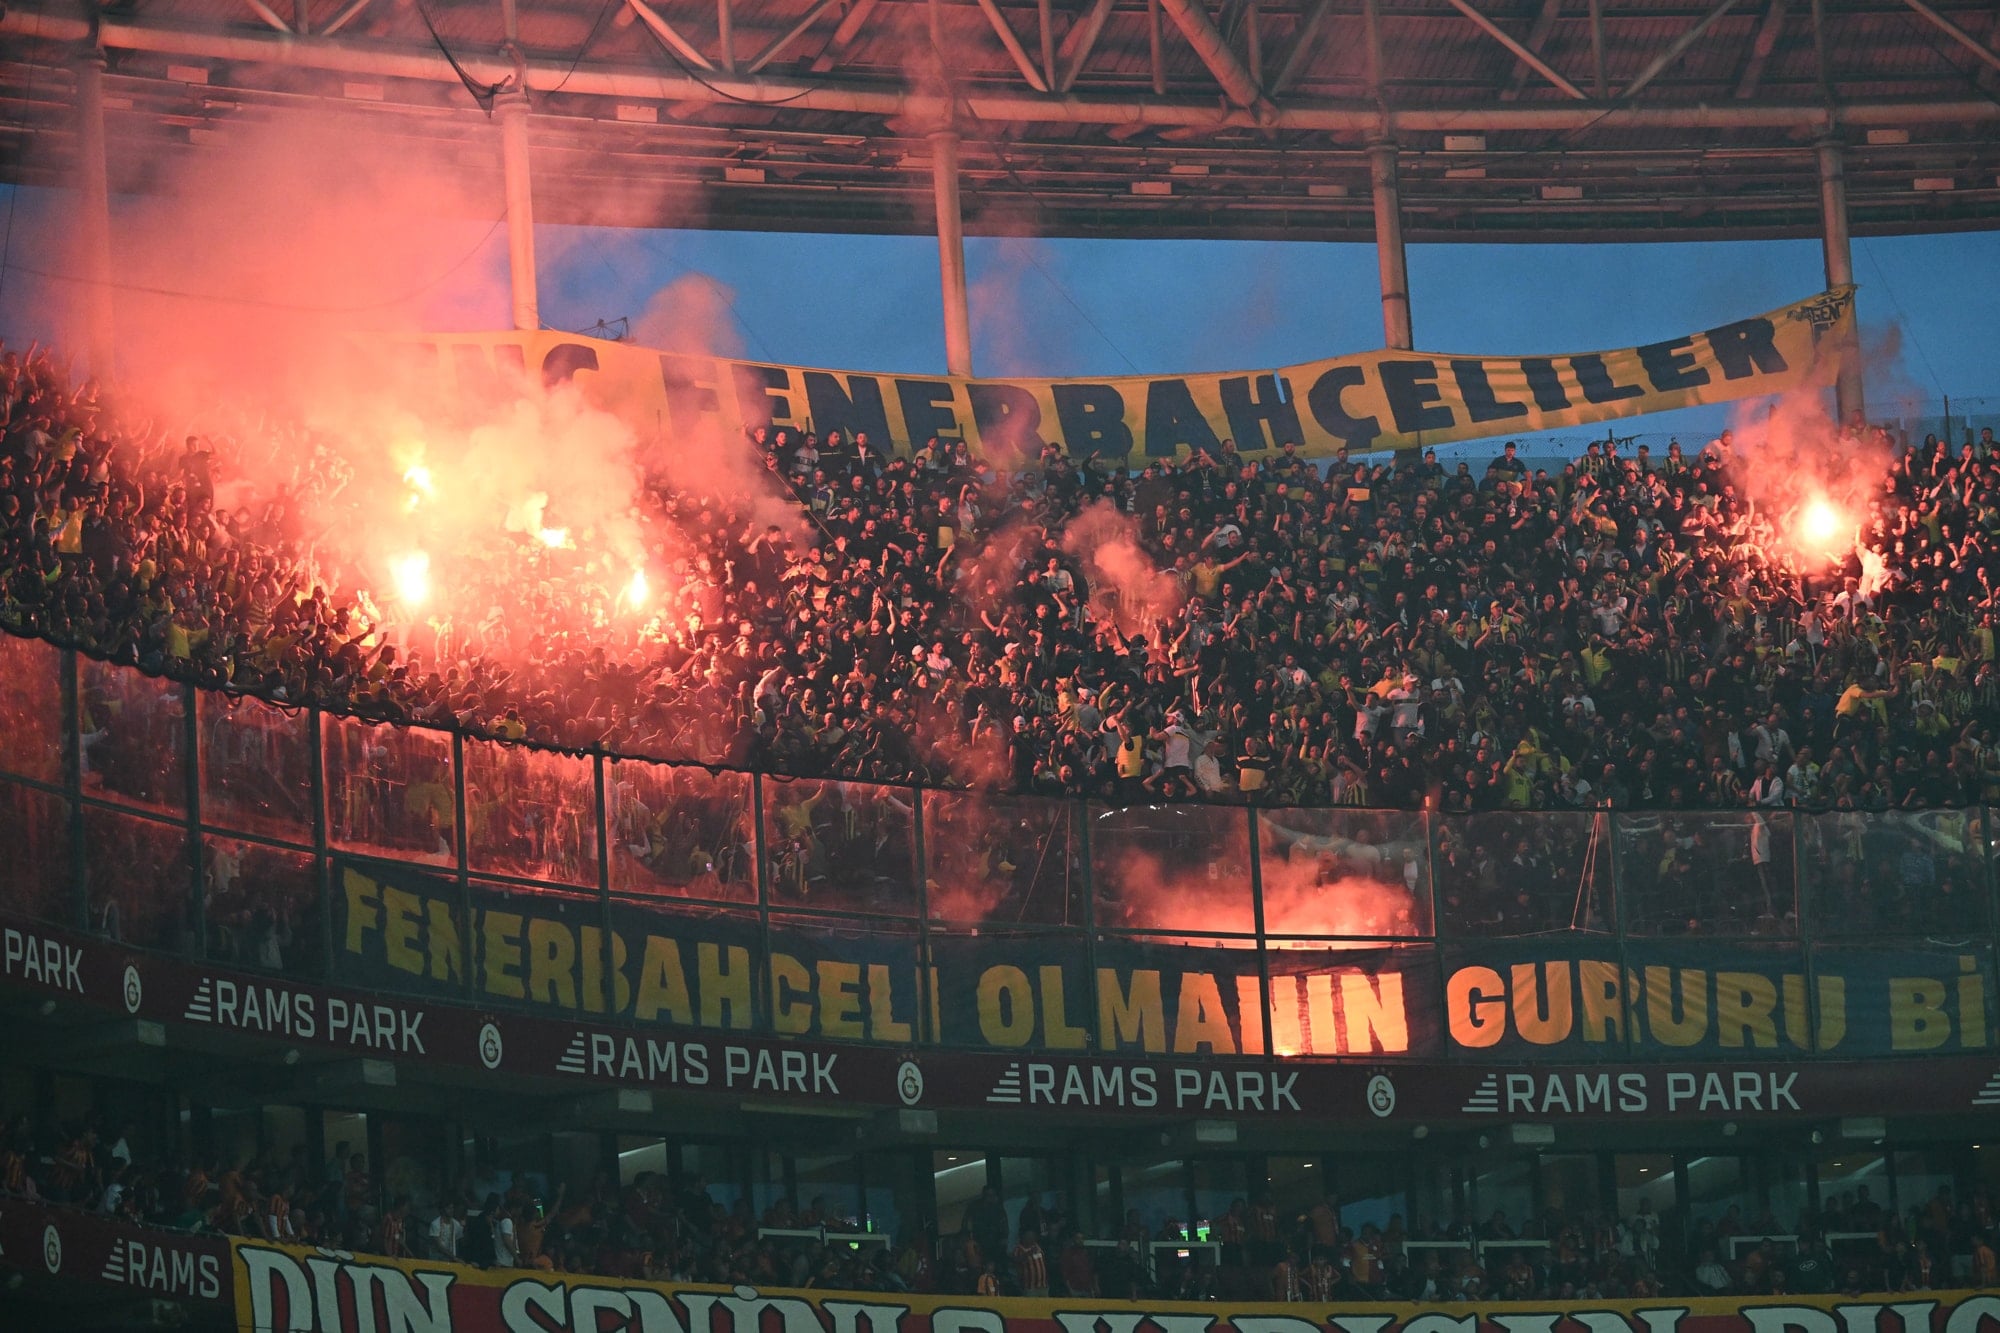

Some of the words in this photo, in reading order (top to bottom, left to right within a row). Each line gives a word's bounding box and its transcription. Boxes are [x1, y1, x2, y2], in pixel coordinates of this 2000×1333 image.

[4, 928, 85, 994] PARK
[216, 980, 316, 1038] RAMS
[327, 998, 426, 1054] PARK
[1446, 960, 1845, 1051] GURURU
[1889, 955, 1998, 1050] Bİ
[591, 1033, 709, 1085] RAMS
[725, 1046, 840, 1095] PARK
[1028, 1063, 1158, 1108] RAMS
[1174, 1068, 1301, 1111] PARK
[1507, 1074, 1647, 1113] RAMS
[1667, 1071, 1801, 1111] PARK
[128, 1240, 220, 1299] RAMS
